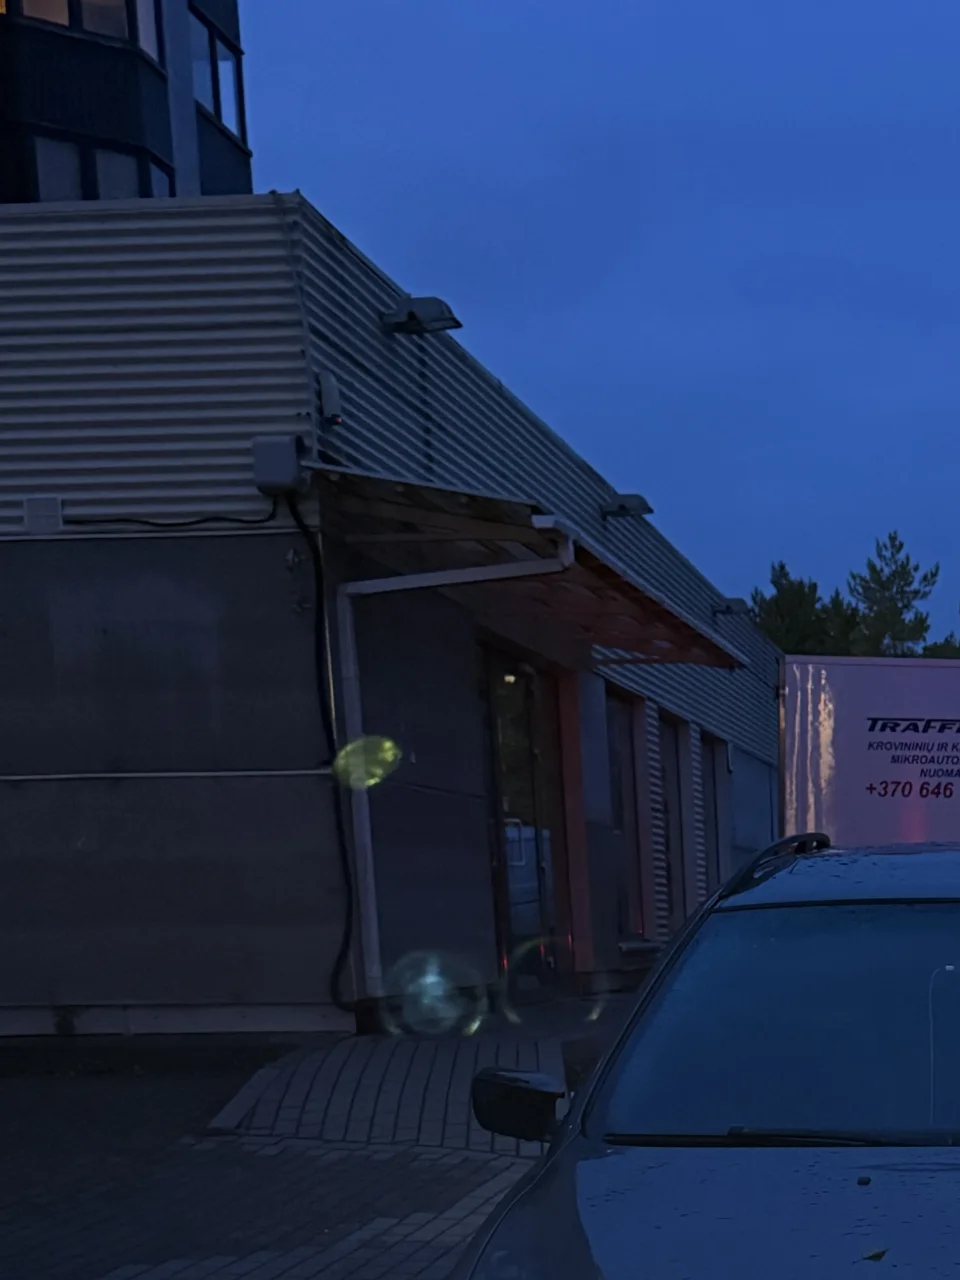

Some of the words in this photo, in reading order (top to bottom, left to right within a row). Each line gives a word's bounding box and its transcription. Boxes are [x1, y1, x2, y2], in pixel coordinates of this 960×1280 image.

[868, 741, 934, 753] KROVININIŲ
[936, 742, 948, 751] IR
[920, 768, 960, 778] NUOMA
[866, 780, 913, 797] +370
[919, 781, 954, 798] 646
